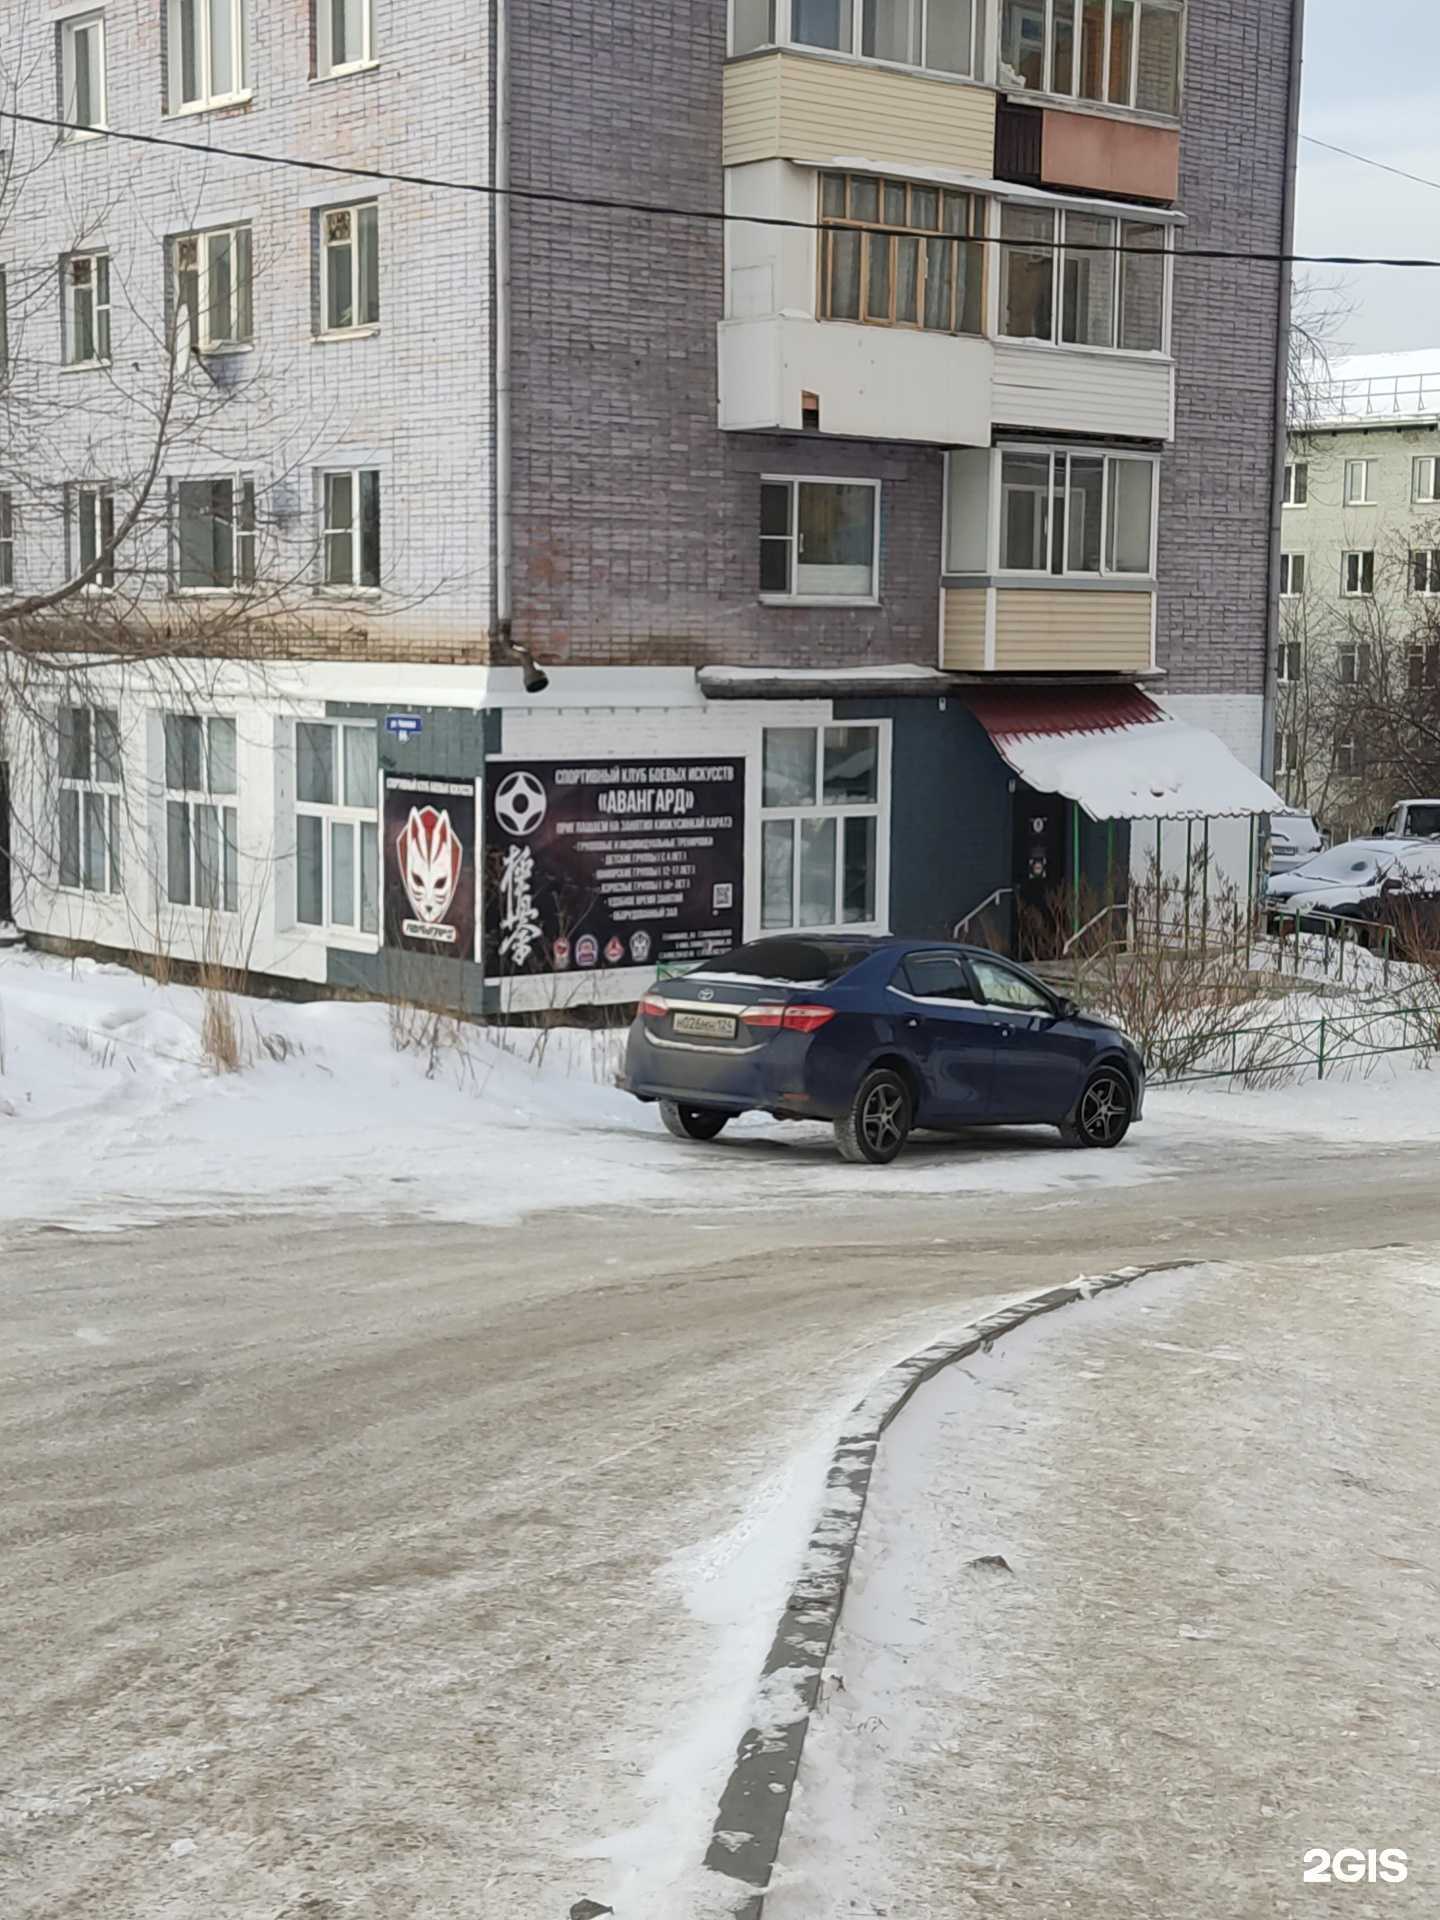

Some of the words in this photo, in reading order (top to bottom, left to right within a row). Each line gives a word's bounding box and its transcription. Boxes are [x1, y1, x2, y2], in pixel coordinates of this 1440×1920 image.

[555, 766, 620, 784] СПОРТИВНЫЙ
[621, 768, 647, 782] КЛУБ
[648, 767, 686, 782] БОЕВЫХ
[688, 766, 734, 781] ИСКУССТВ
[598, 789, 694, 814] «АВАНГАРД»
